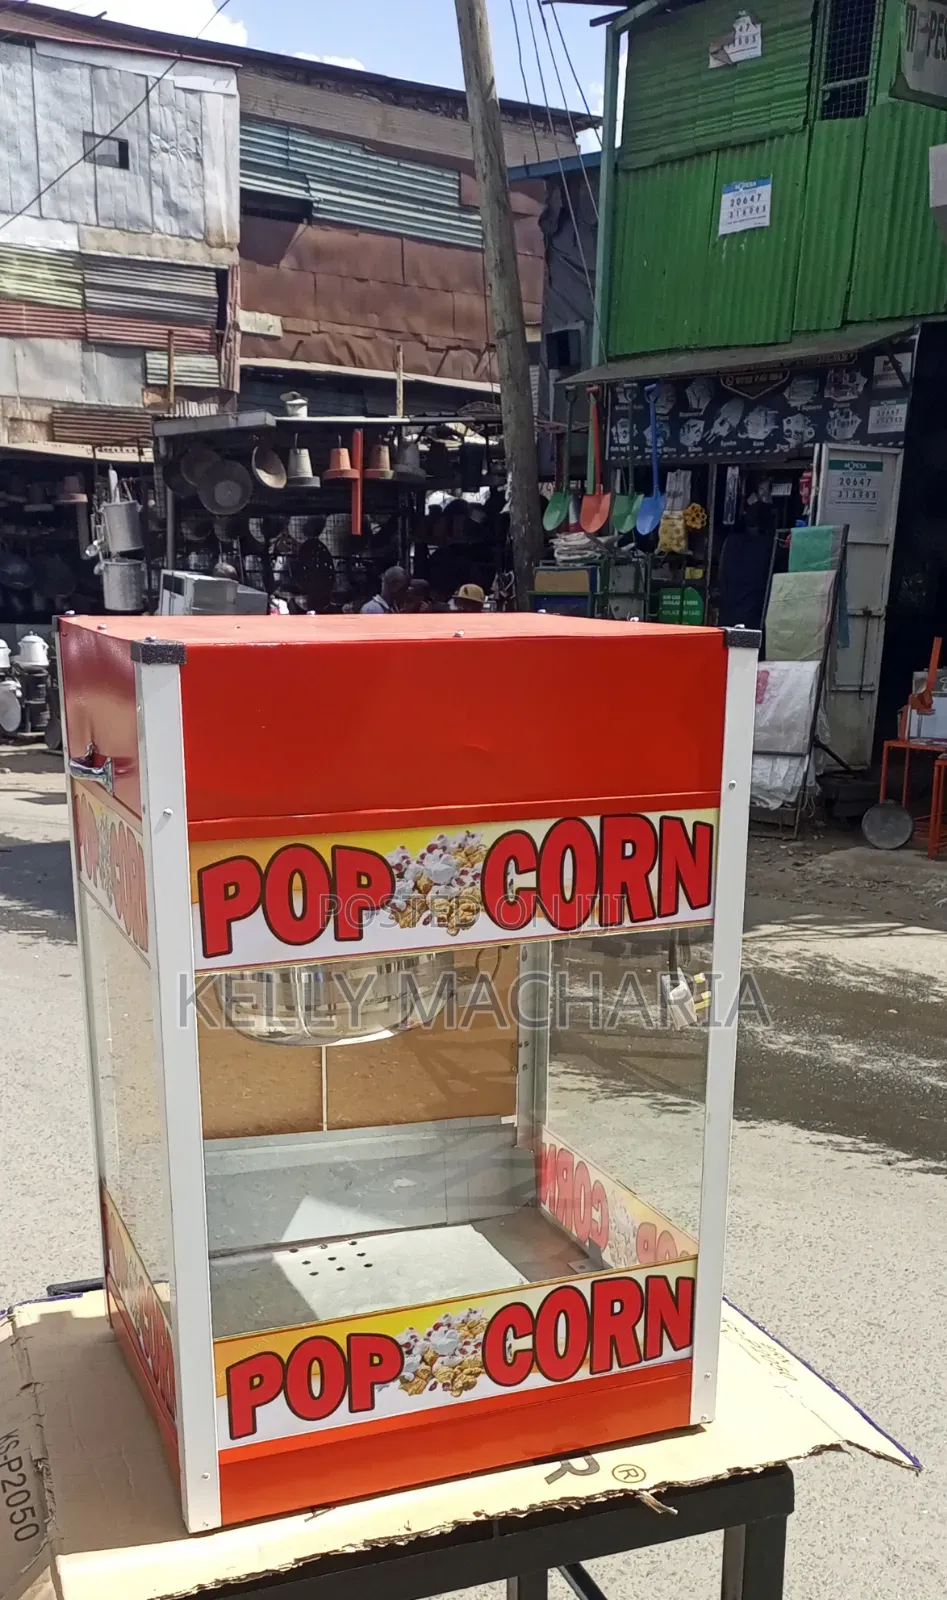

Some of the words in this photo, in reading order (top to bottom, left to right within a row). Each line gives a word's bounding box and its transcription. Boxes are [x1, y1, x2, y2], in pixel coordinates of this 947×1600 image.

[730, 193, 761, 207] 20647
[839, 477, 872, 487] 20647
[198, 843, 396, 958] POP
[480, 813, 714, 932] CORN
[226, 1335, 404, 1439] POP
[482, 1275, 695, 1386] CORN
[0, 1428, 40, 1542] KS-P2050
